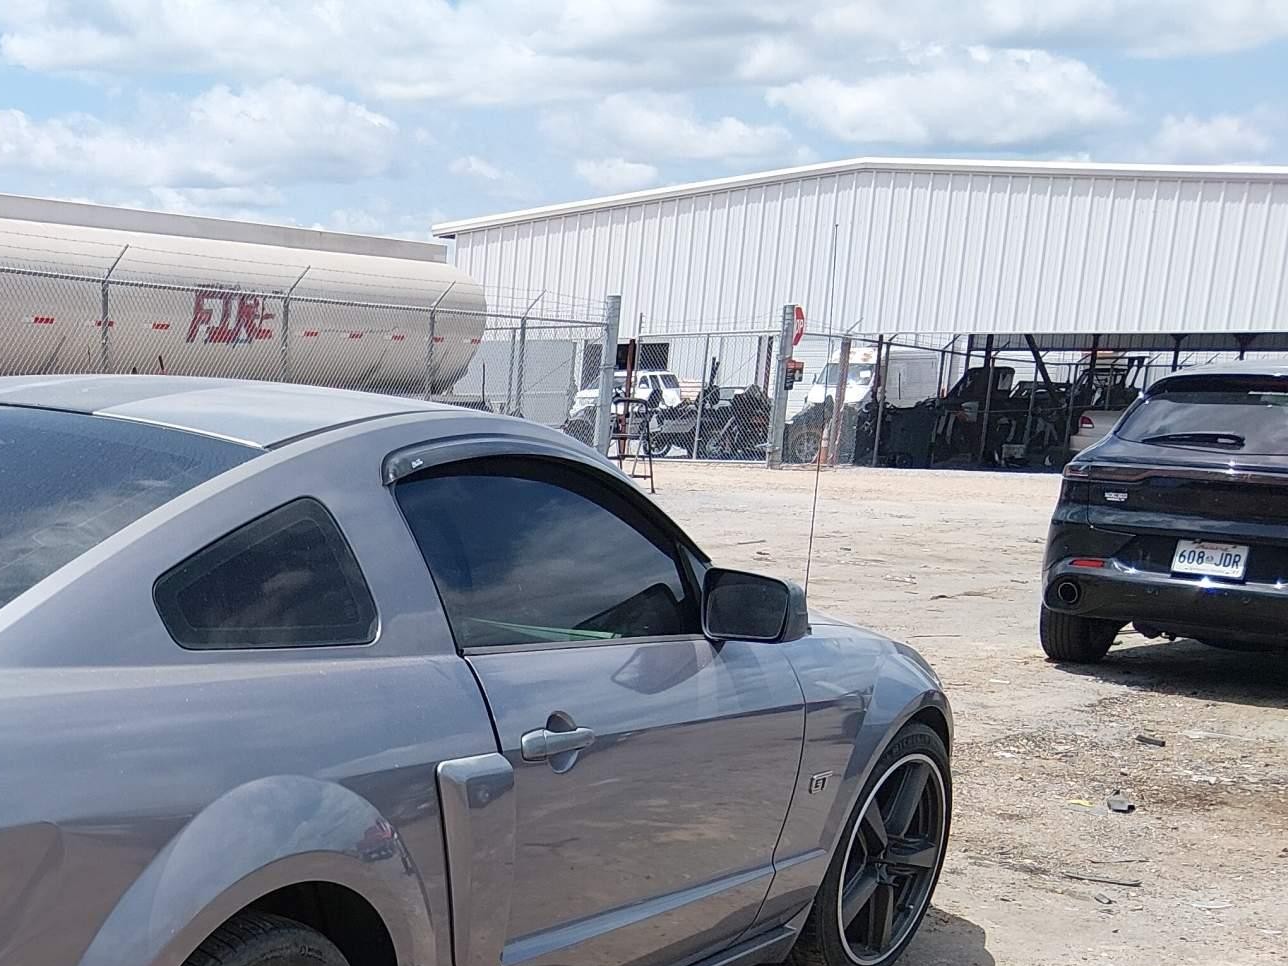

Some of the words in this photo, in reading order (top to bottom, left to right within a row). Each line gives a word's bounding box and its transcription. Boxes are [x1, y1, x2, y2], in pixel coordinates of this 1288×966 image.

[1178, 549, 1205, 565] 608
[1214, 552, 1242, 570] JDR
[810, 770, 832, 793] GT
